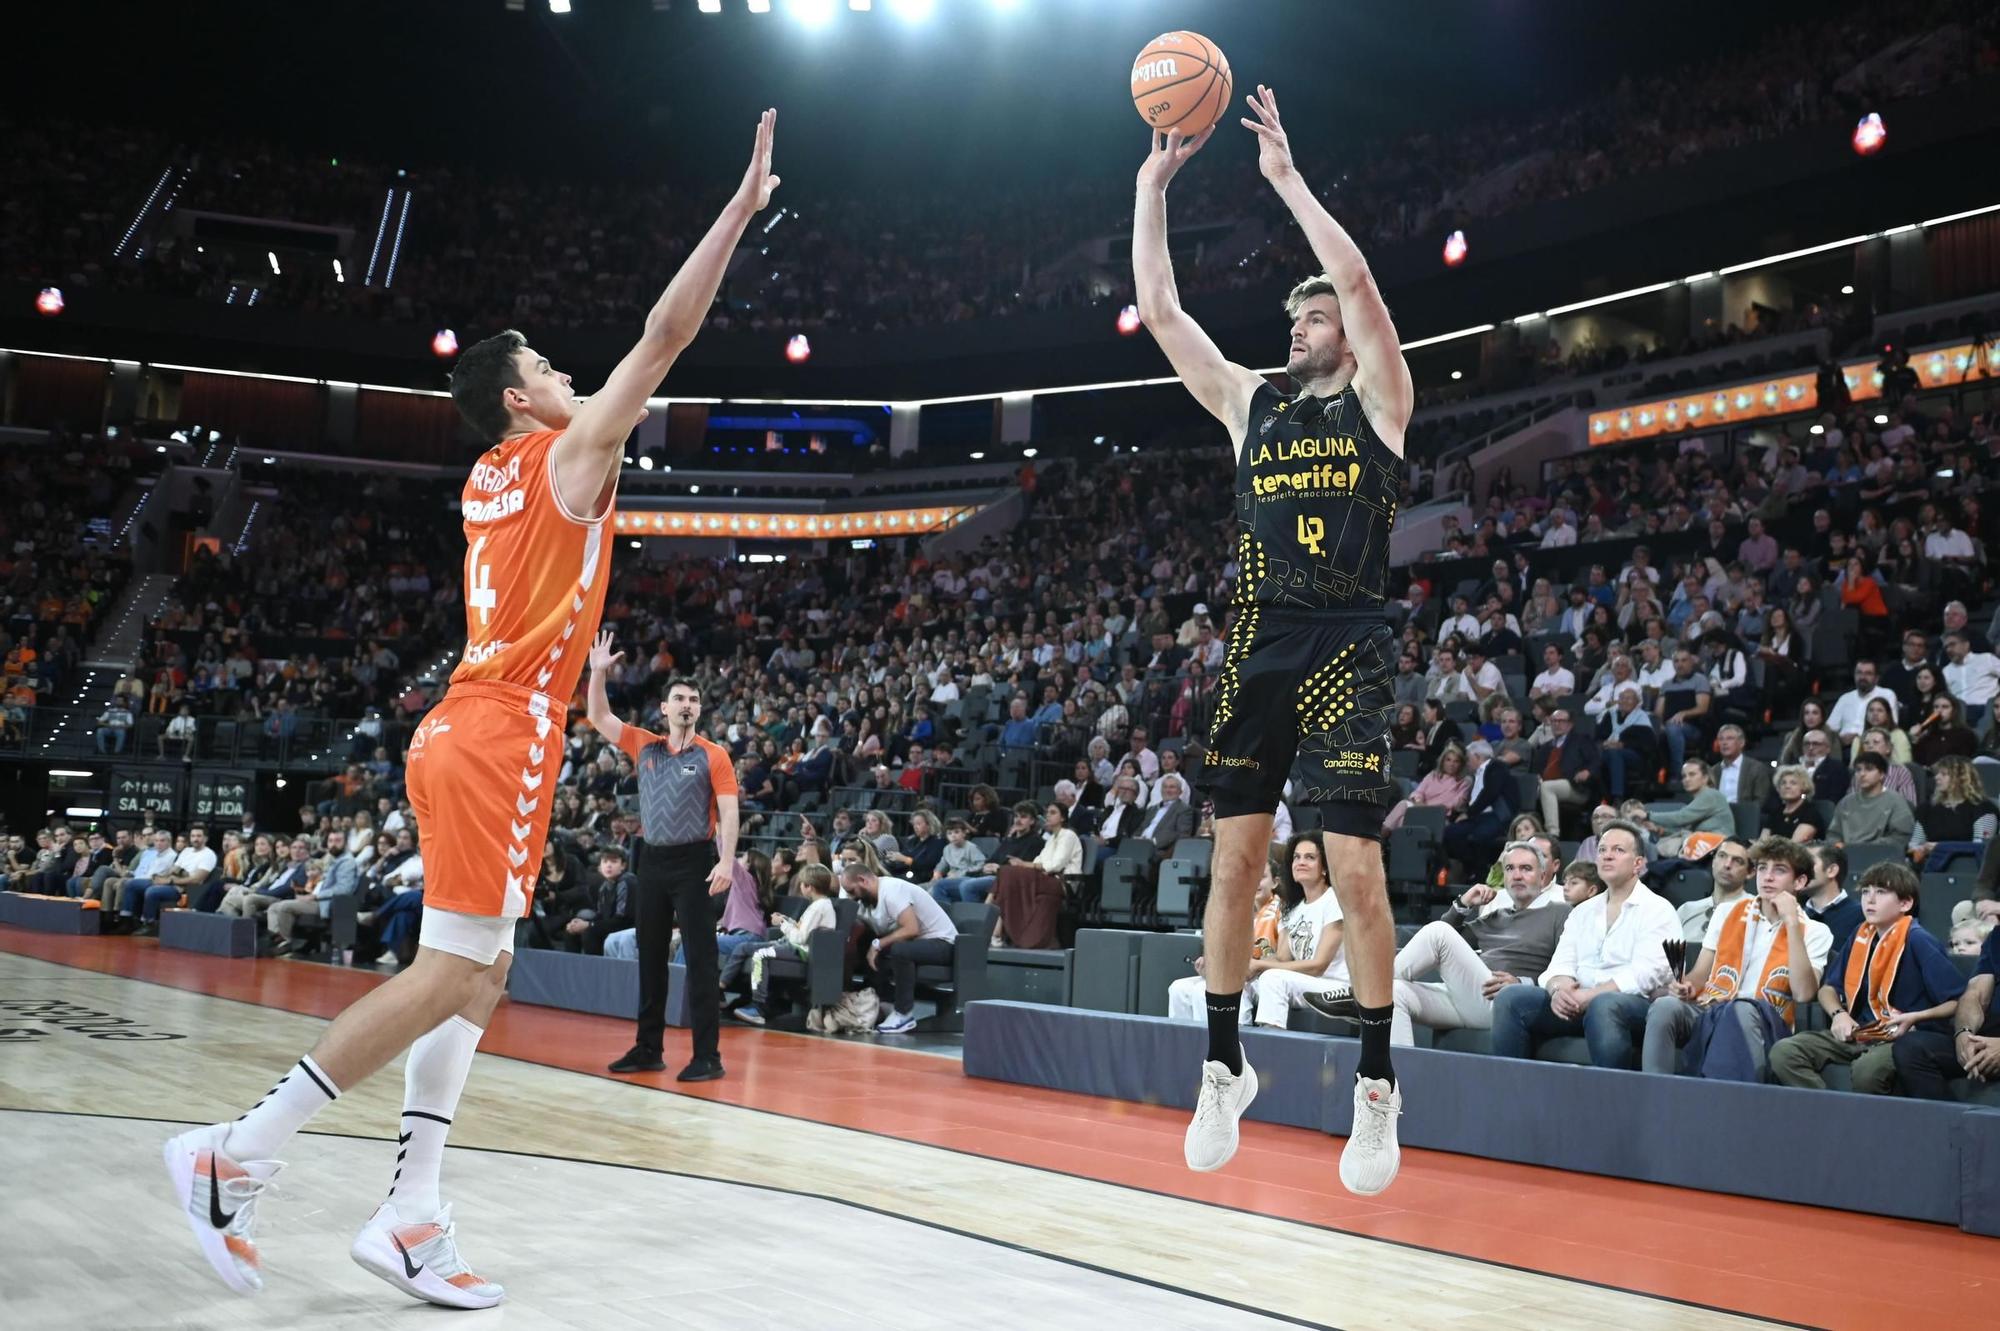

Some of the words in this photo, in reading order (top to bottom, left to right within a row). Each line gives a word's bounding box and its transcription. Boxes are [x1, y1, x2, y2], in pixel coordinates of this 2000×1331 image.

[1131, 58, 1178, 82] Wilso
[1148, 101, 1170, 116] acb
[1250, 443, 1273, 467] LA
[1277, 437, 1359, 461] LAGUNA
[1298, 489, 1347, 499] emociones
[469, 536, 497, 625] 4
[1339, 750, 1364, 761] Islas
[1323, 758, 1364, 769] Canarias
[119, 797, 171, 813] SAIDA
